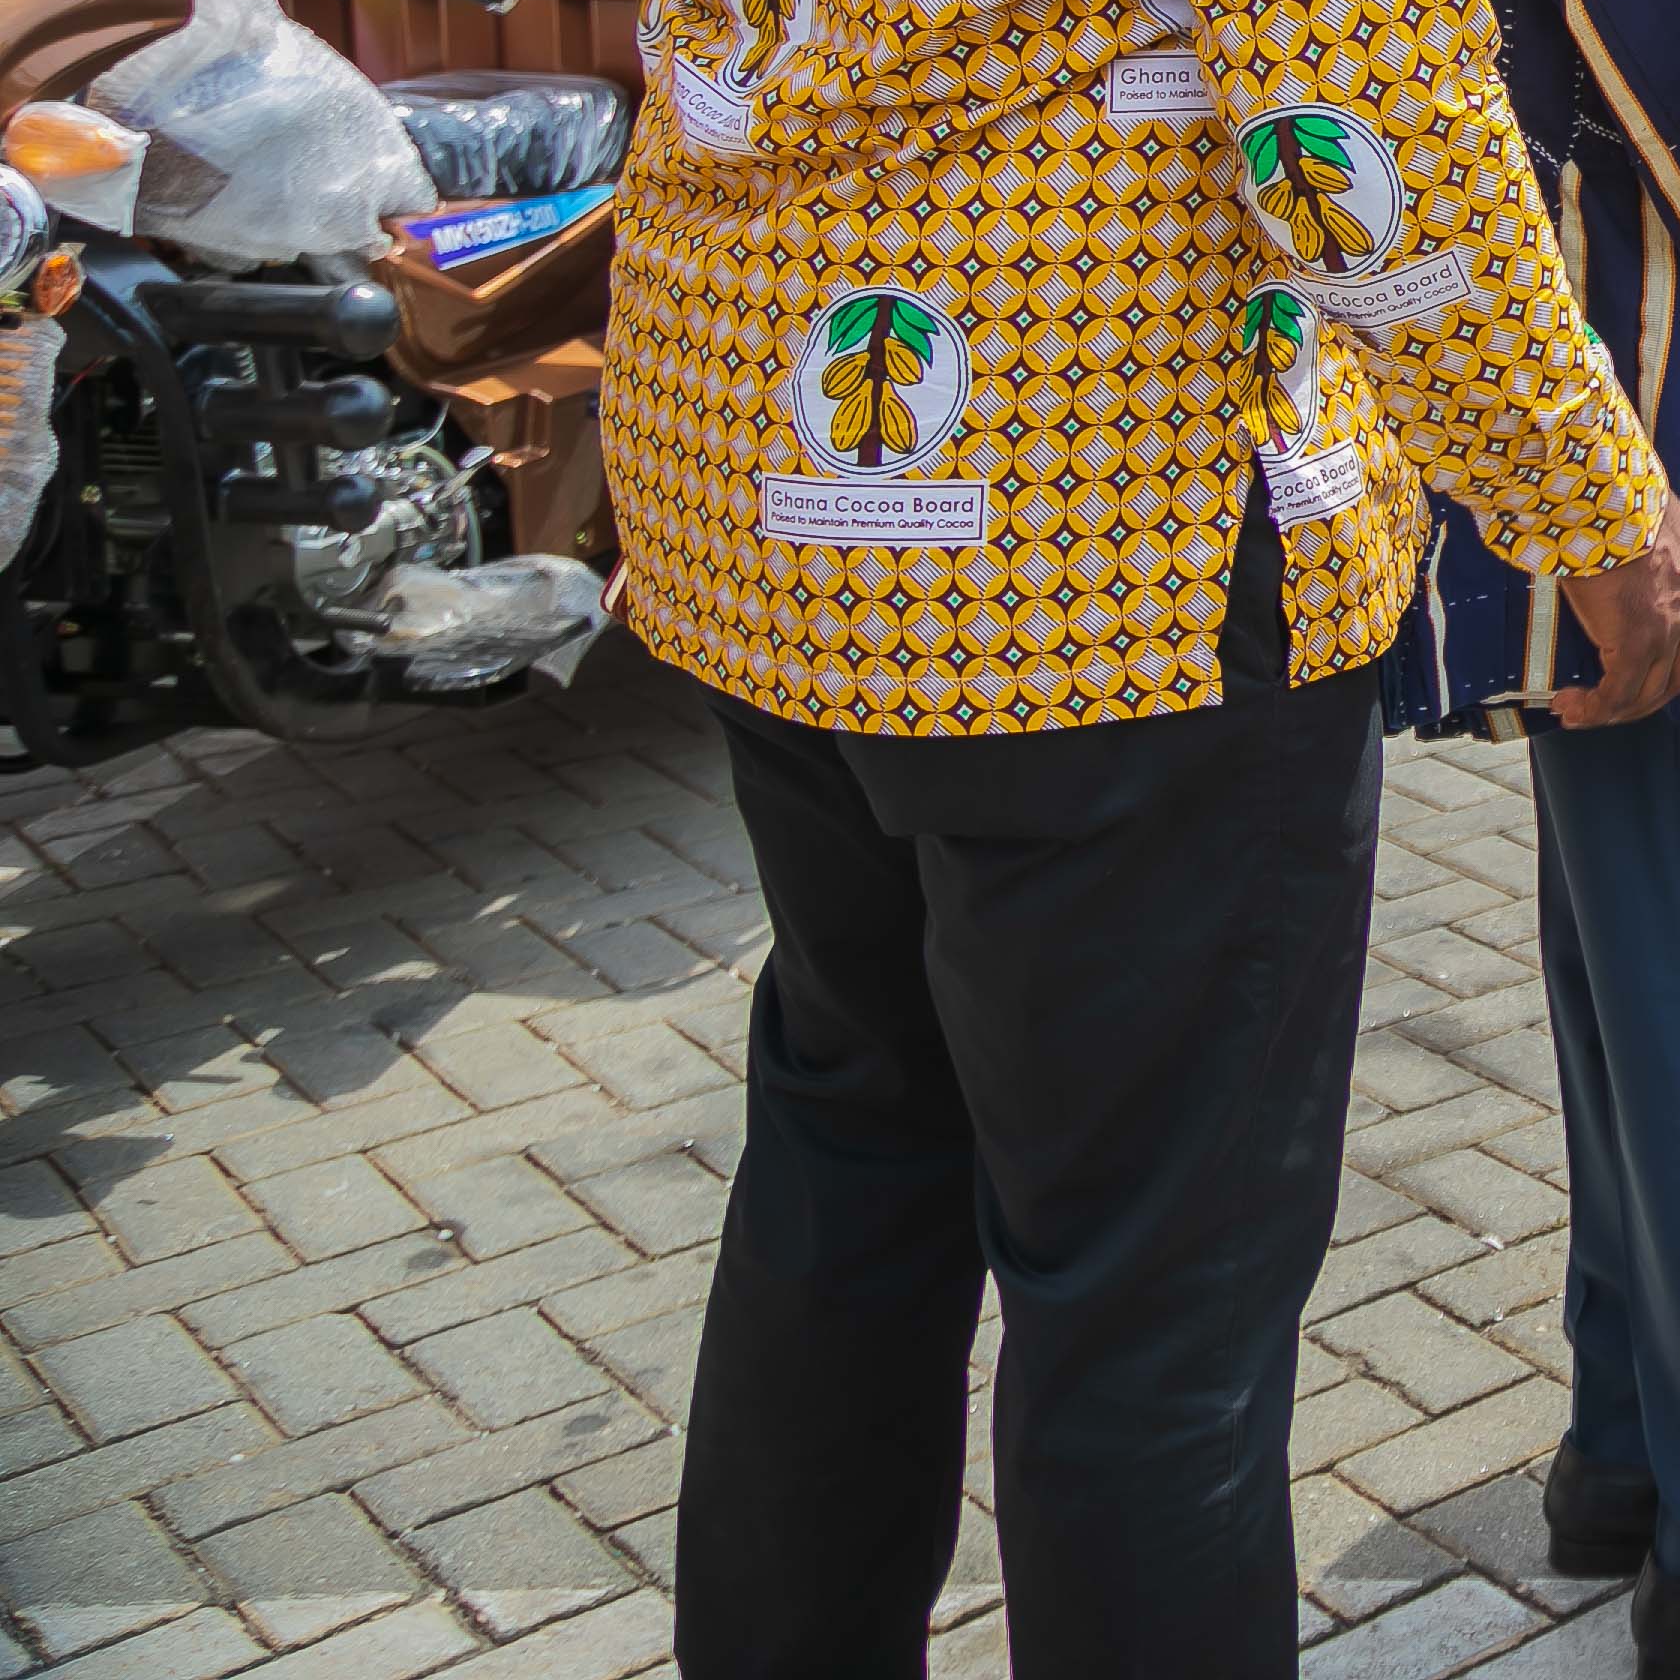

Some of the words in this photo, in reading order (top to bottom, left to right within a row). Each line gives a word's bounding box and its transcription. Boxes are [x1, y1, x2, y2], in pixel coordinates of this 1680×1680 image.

[1121, 68, 1190, 85] Ghana
[1120, 90, 1153, 100] Poised
[1156, 89, 1167, 99] to
[688, 93, 723, 121] Cocoa
[1329, 290, 1388, 308] Cocoa
[1393, 264, 1453, 297] Board
[1348, 308, 1386, 320] Premium
[1387, 296, 1422, 313] Quality
[1424, 282, 1459, 299] Cocoa
[1270, 476, 1321, 501] Cocoa
[1320, 456, 1356, 484] Board
[771, 490, 828, 511] Ghana
[835, 496, 904, 513] Cocoa
[913, 497, 974, 513] Board
[1287, 495, 1321, 509] Premium
[771, 511, 796, 524] Poised
[797, 515, 807, 525] to
[808, 517, 848, 528] Maintain
[852, 519, 895, 529] Premium
[897, 519, 934, 531] Quality
[936, 519, 974, 529] Cocoa
